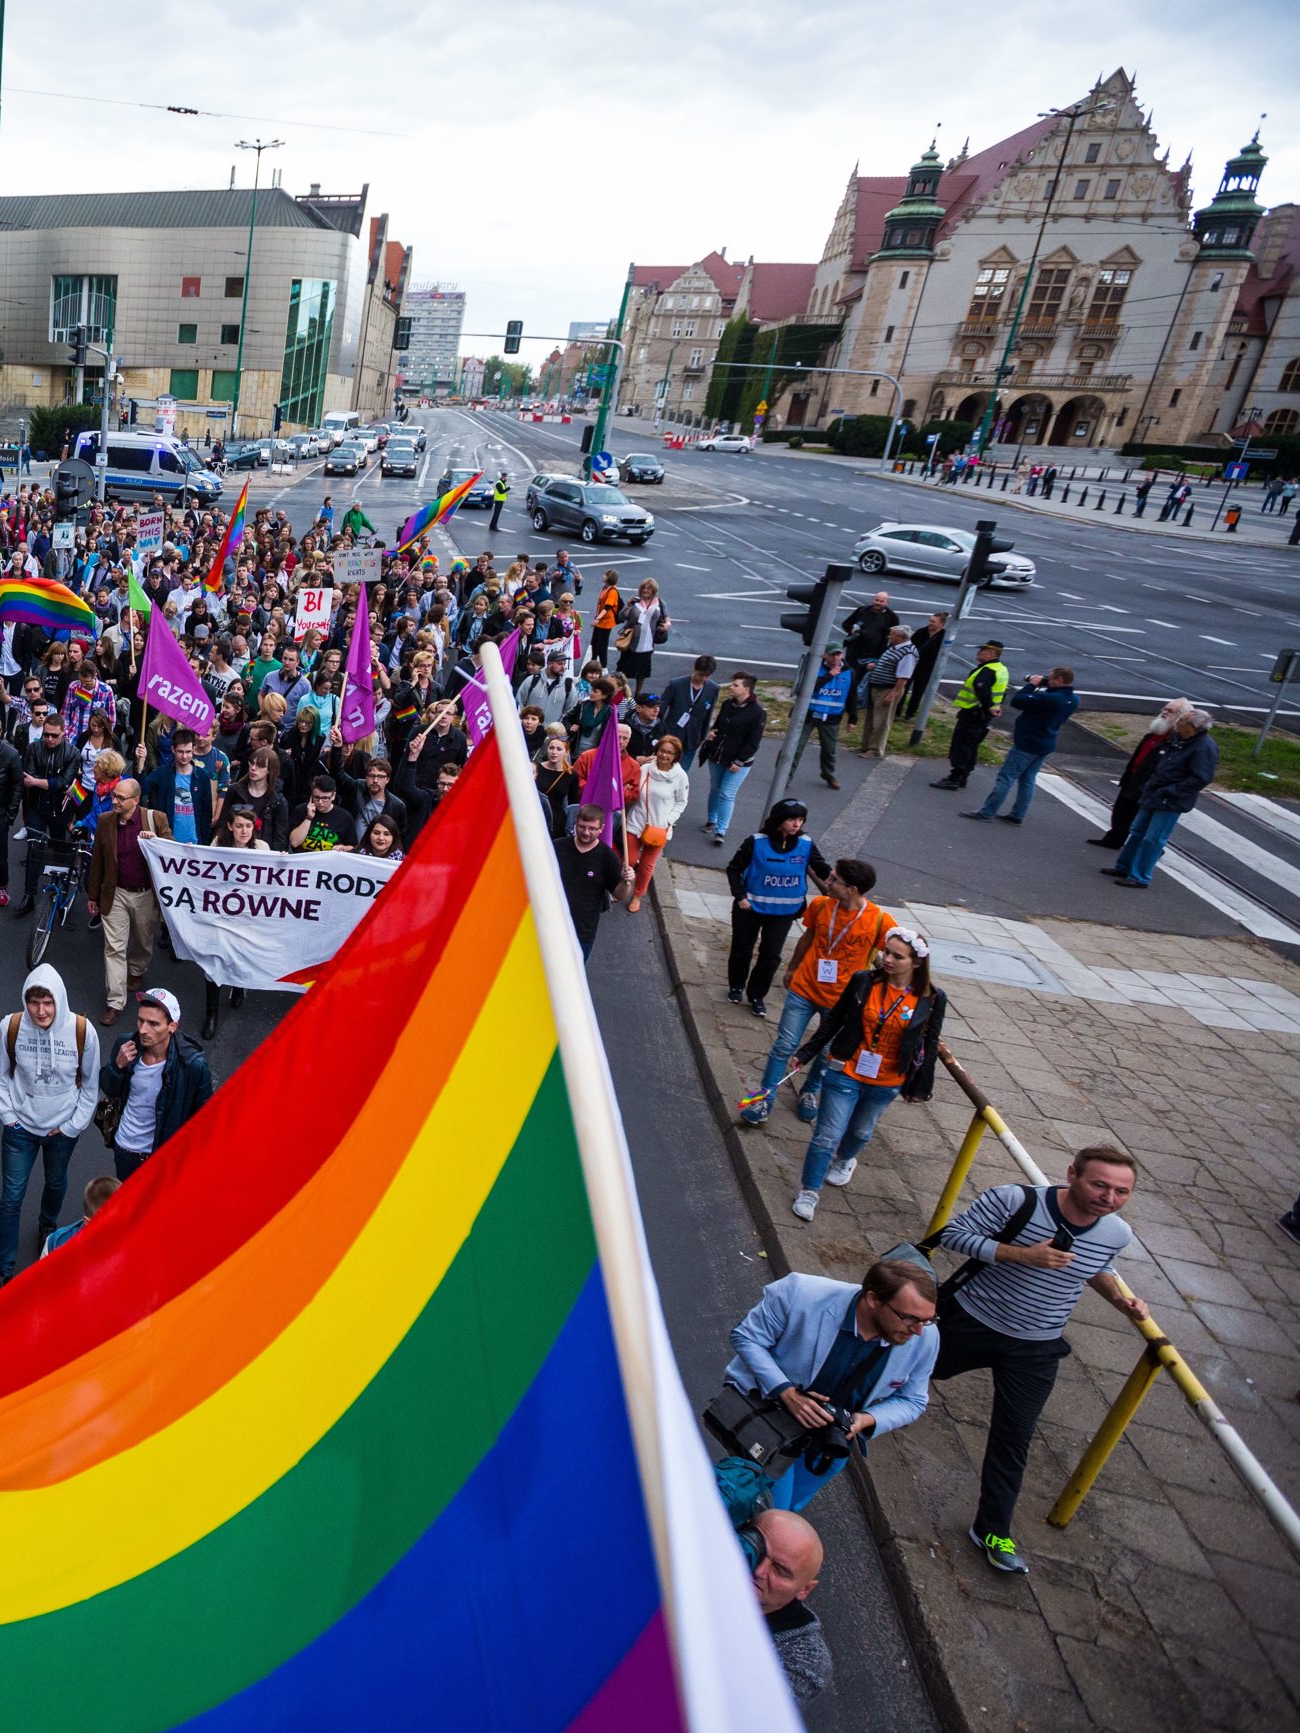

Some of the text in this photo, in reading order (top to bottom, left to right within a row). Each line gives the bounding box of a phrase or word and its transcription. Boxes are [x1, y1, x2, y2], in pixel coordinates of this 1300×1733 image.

[140, 516, 162, 528] BORN
[138, 527, 161, 538] THIS
[140, 536, 160, 548] WAY
[303, 591, 323, 612] BI
[147, 674, 209, 721] razem
[819, 688, 842, 696] POLICJA
[158, 855, 311, 889] WSZYSTKIE
[764, 875, 799, 887] POLICJA
[158, 885, 322, 922] SĄ RÓWNE
